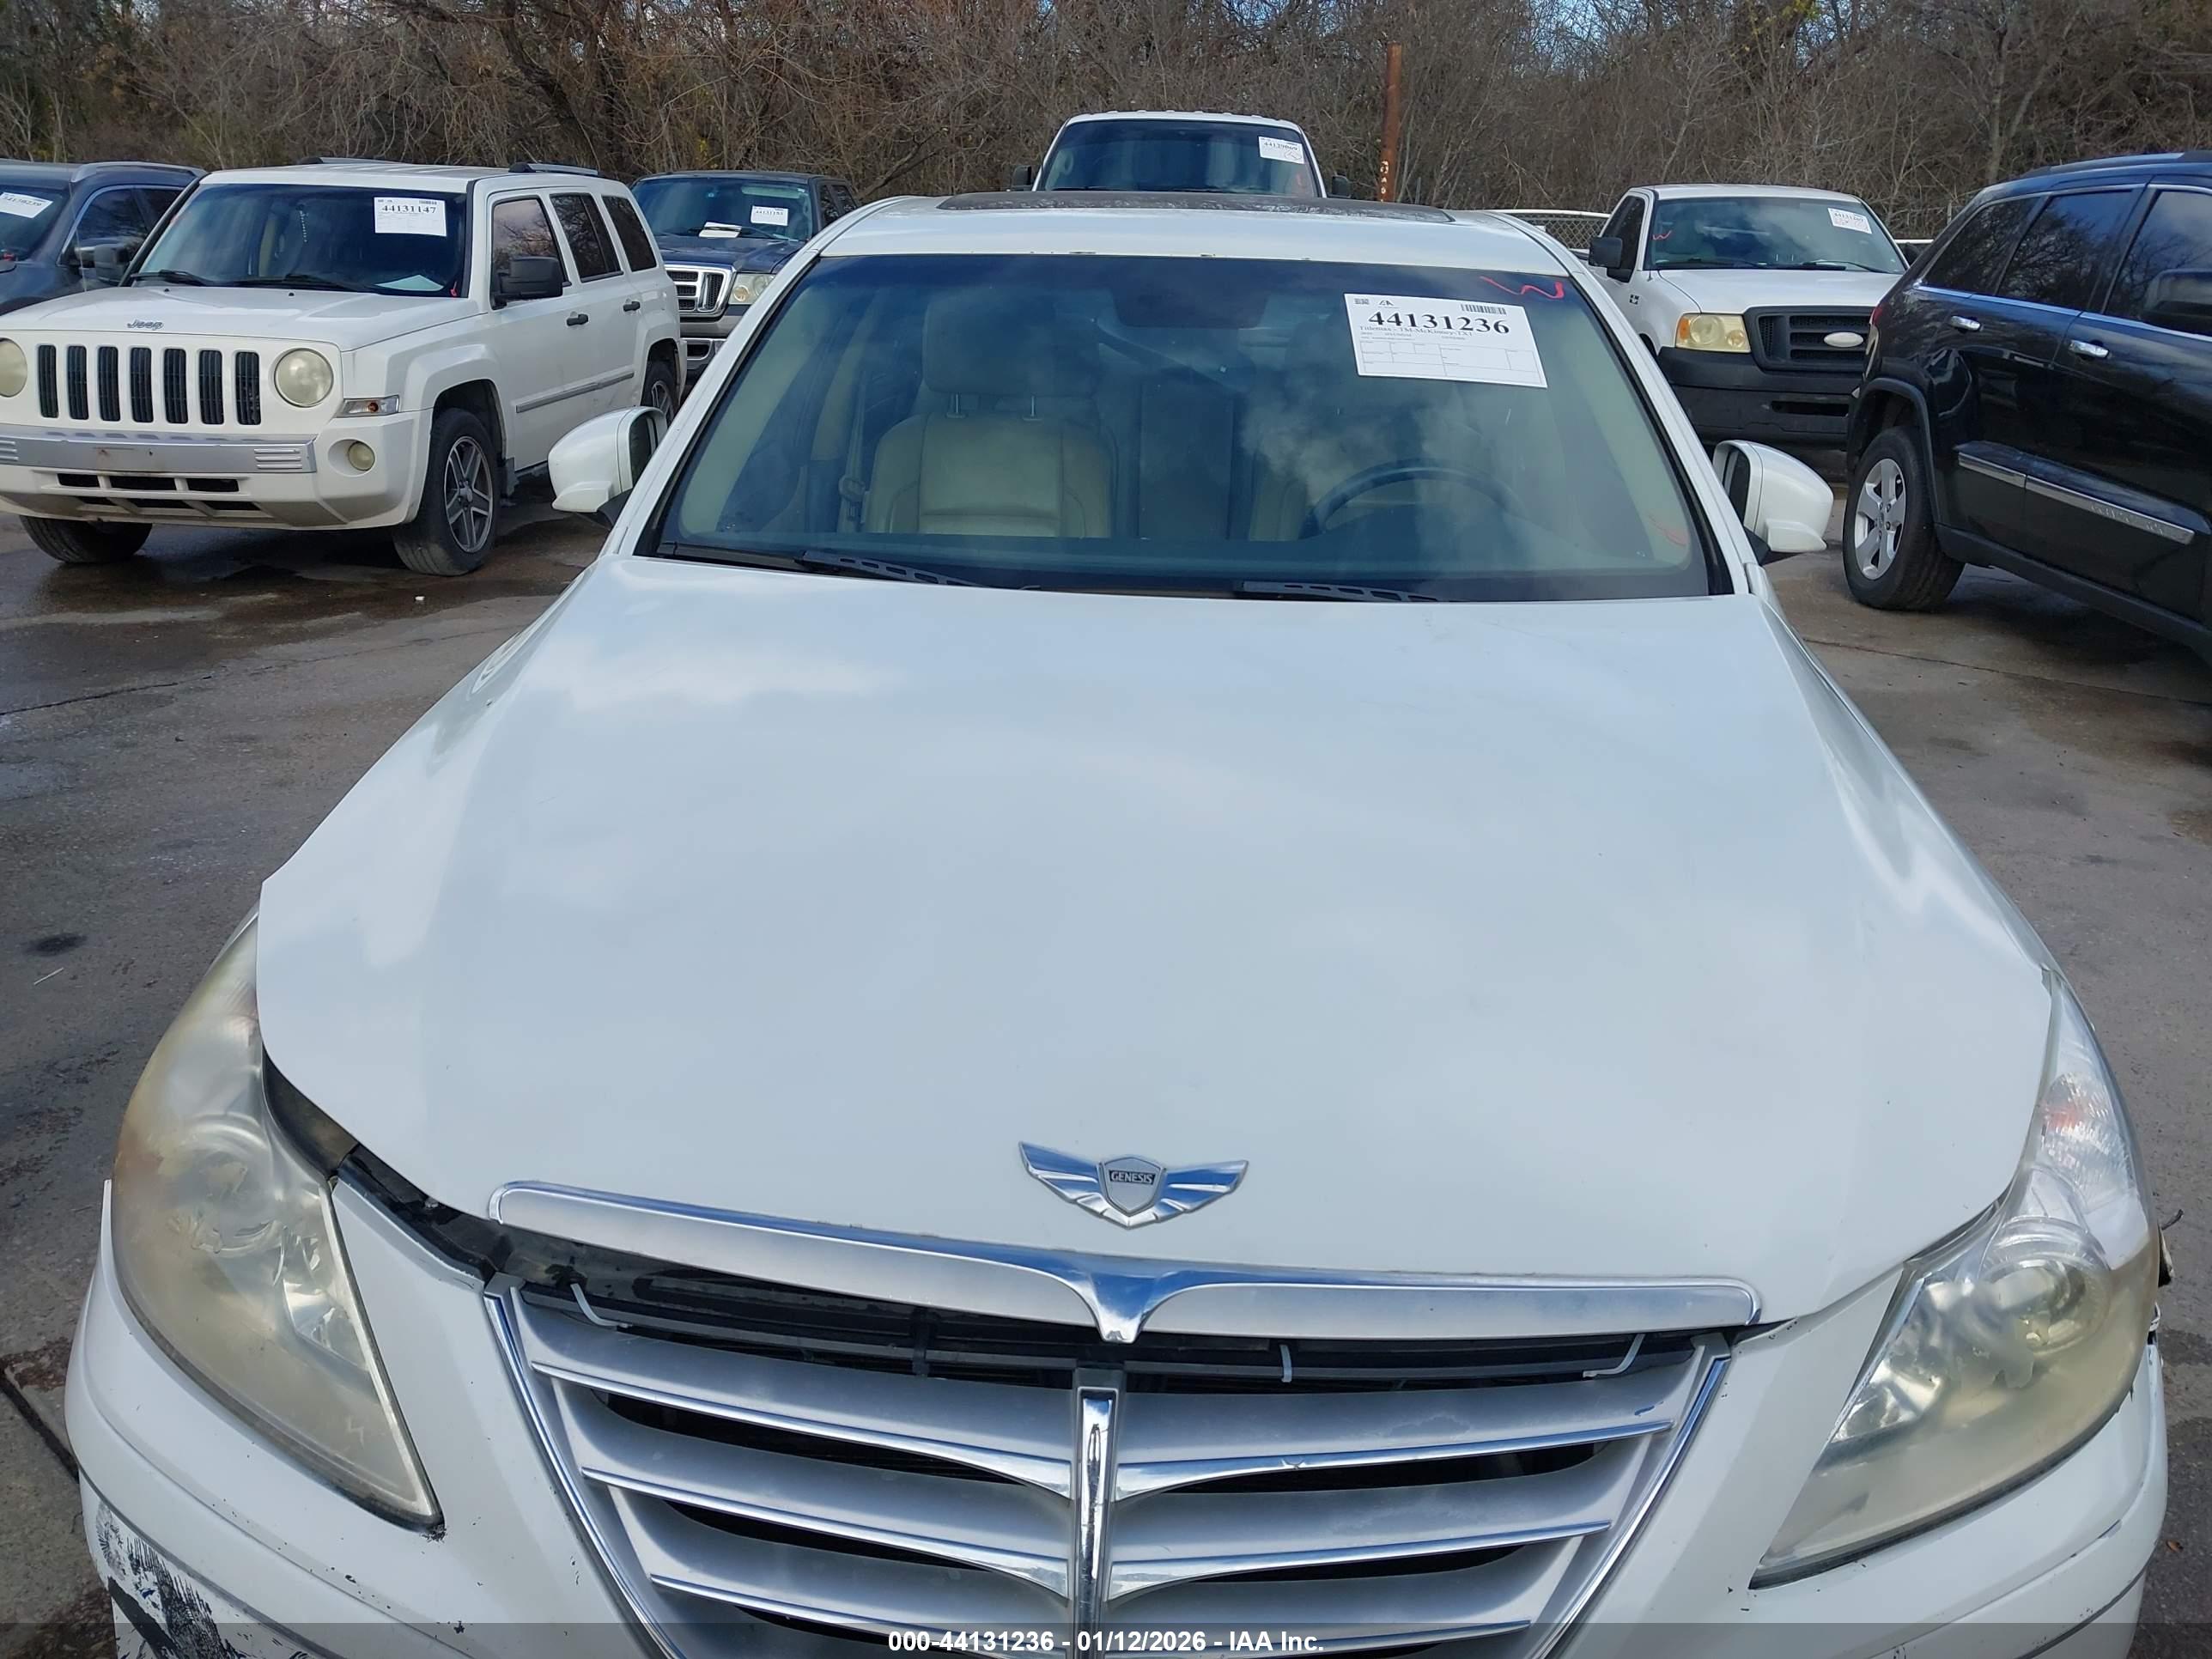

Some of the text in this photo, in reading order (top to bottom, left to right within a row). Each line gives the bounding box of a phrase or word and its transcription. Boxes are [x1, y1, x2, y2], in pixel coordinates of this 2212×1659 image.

[381, 204, 436, 214] 44131147
[127, 319, 164, 331] Jeep
[1368, 311, 1510, 335] 44131236
[1110, 1170, 1154, 1184] GENESIS
